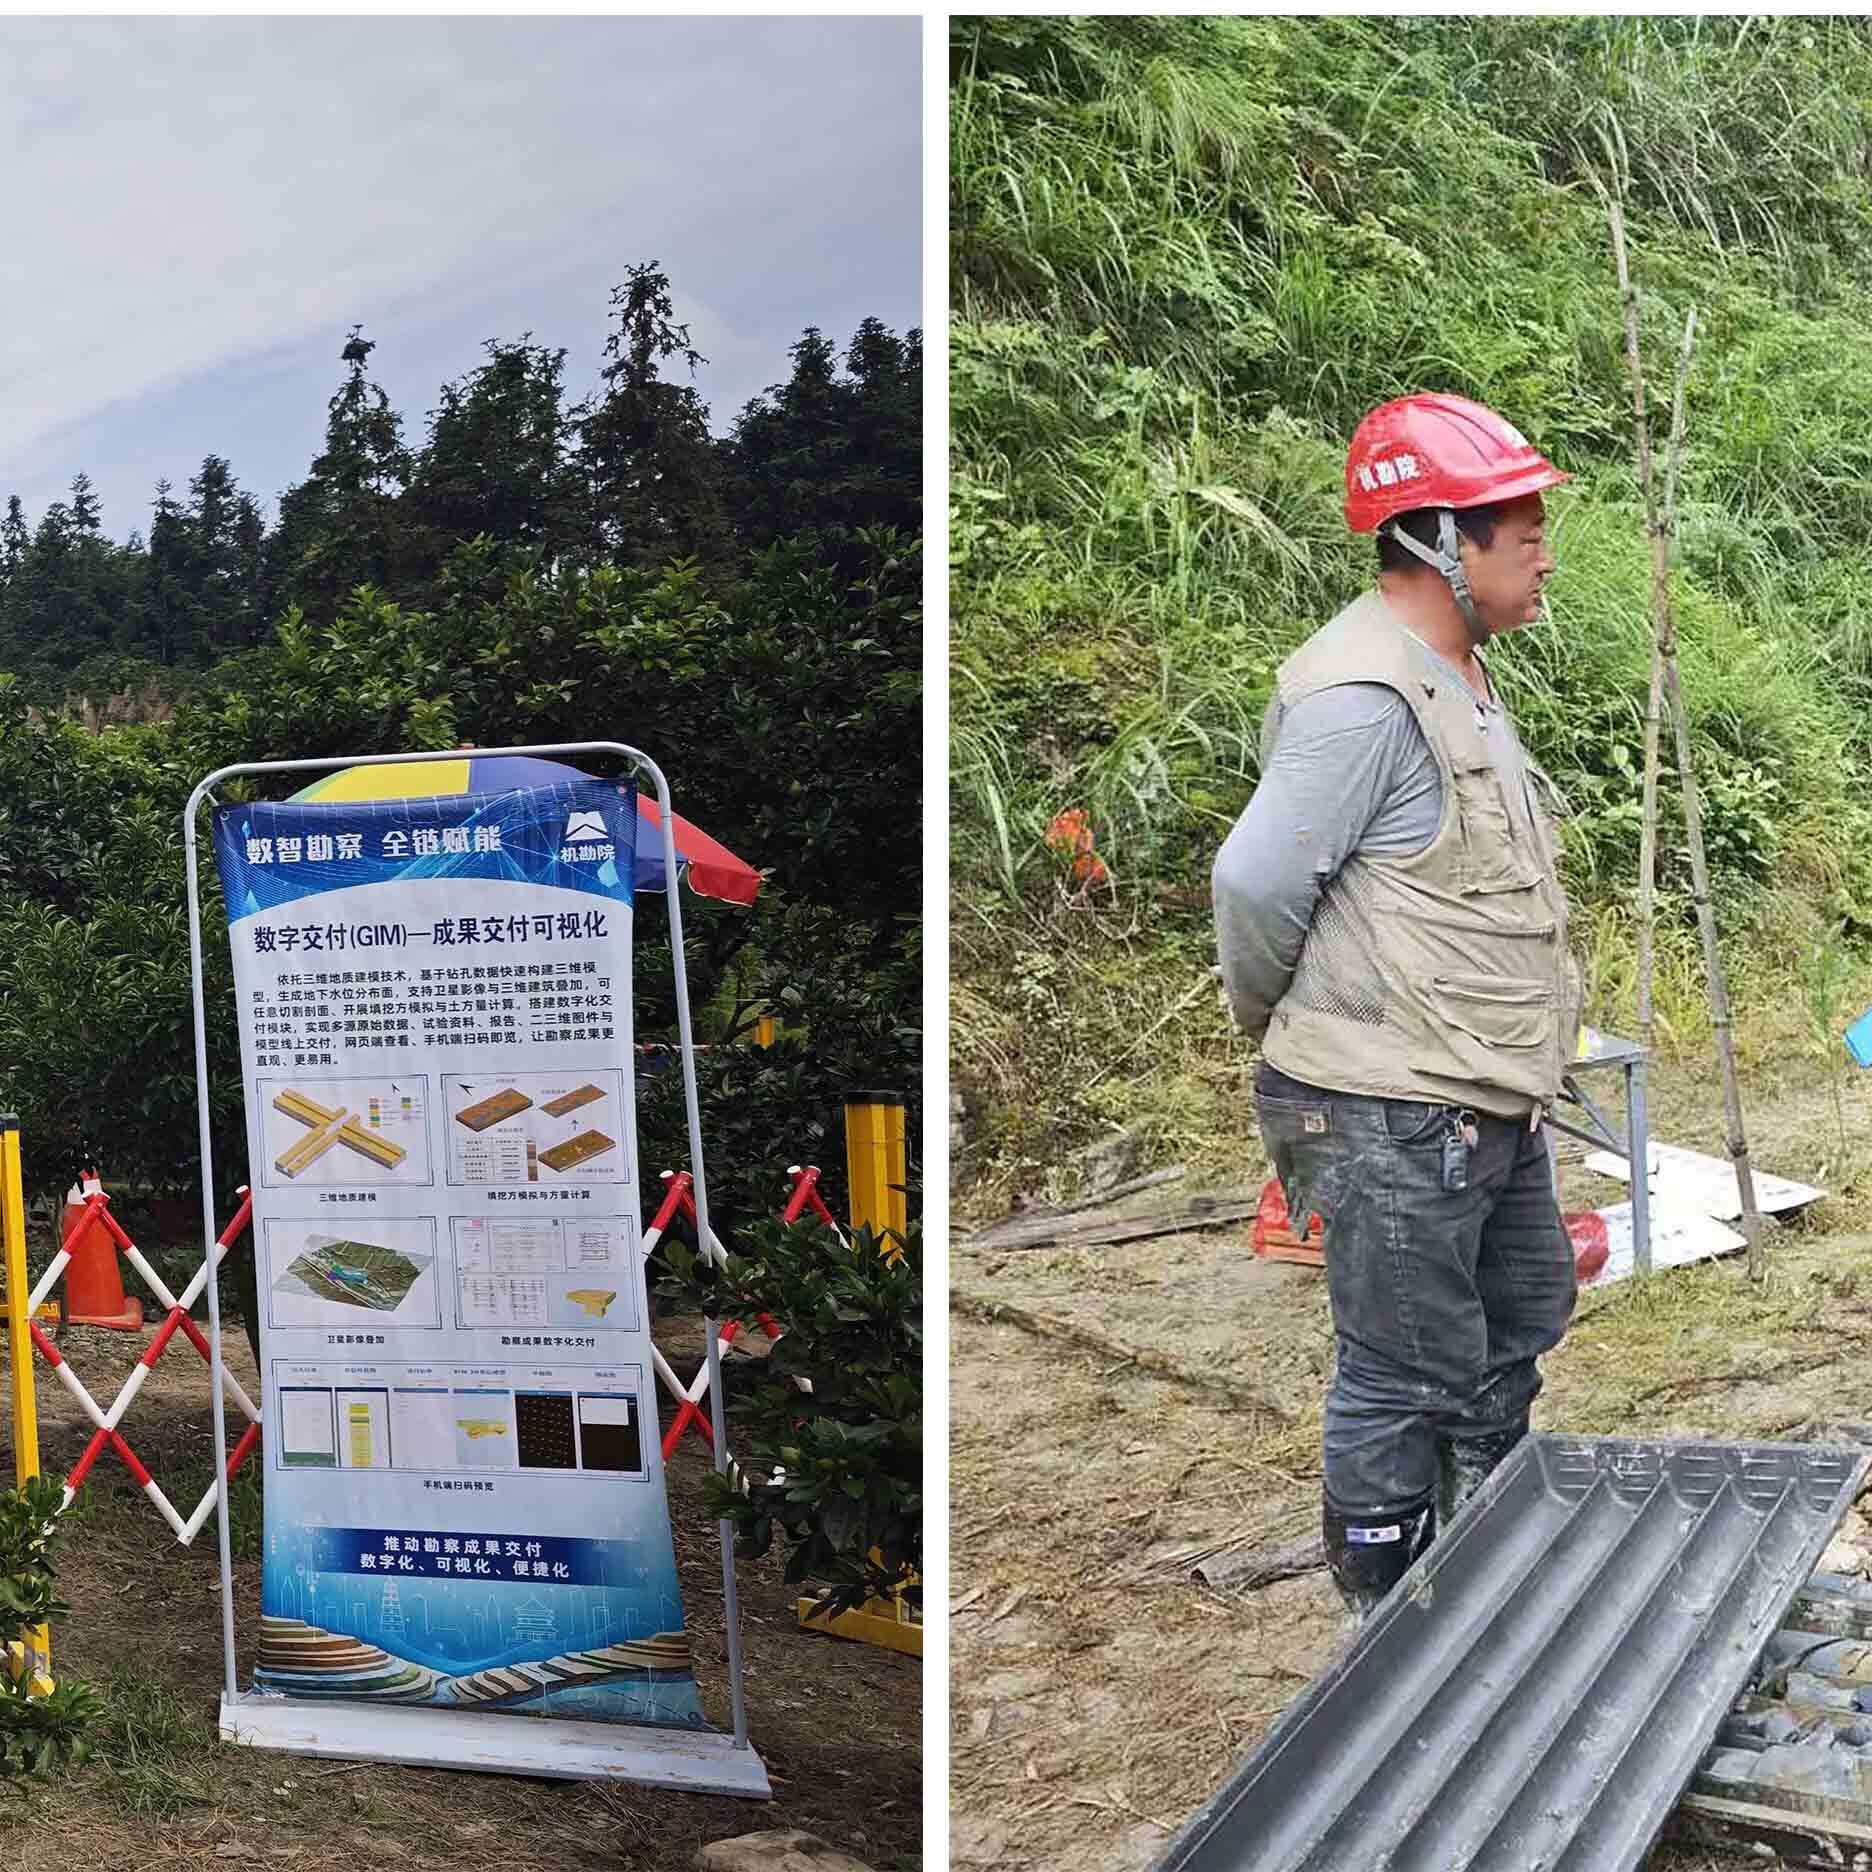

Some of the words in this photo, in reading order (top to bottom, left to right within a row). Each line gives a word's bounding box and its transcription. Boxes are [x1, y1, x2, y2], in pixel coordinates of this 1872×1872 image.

[245, 832, 363, 867] 数智勘察
[382, 824, 503, 860] 全链赋能
[559, 843, 616, 864] 机勘院
[383, 1535, 543, 1558] 推动勘察成果交付
[359, 1552, 570, 1579] 数字化、可视化、便捷化
